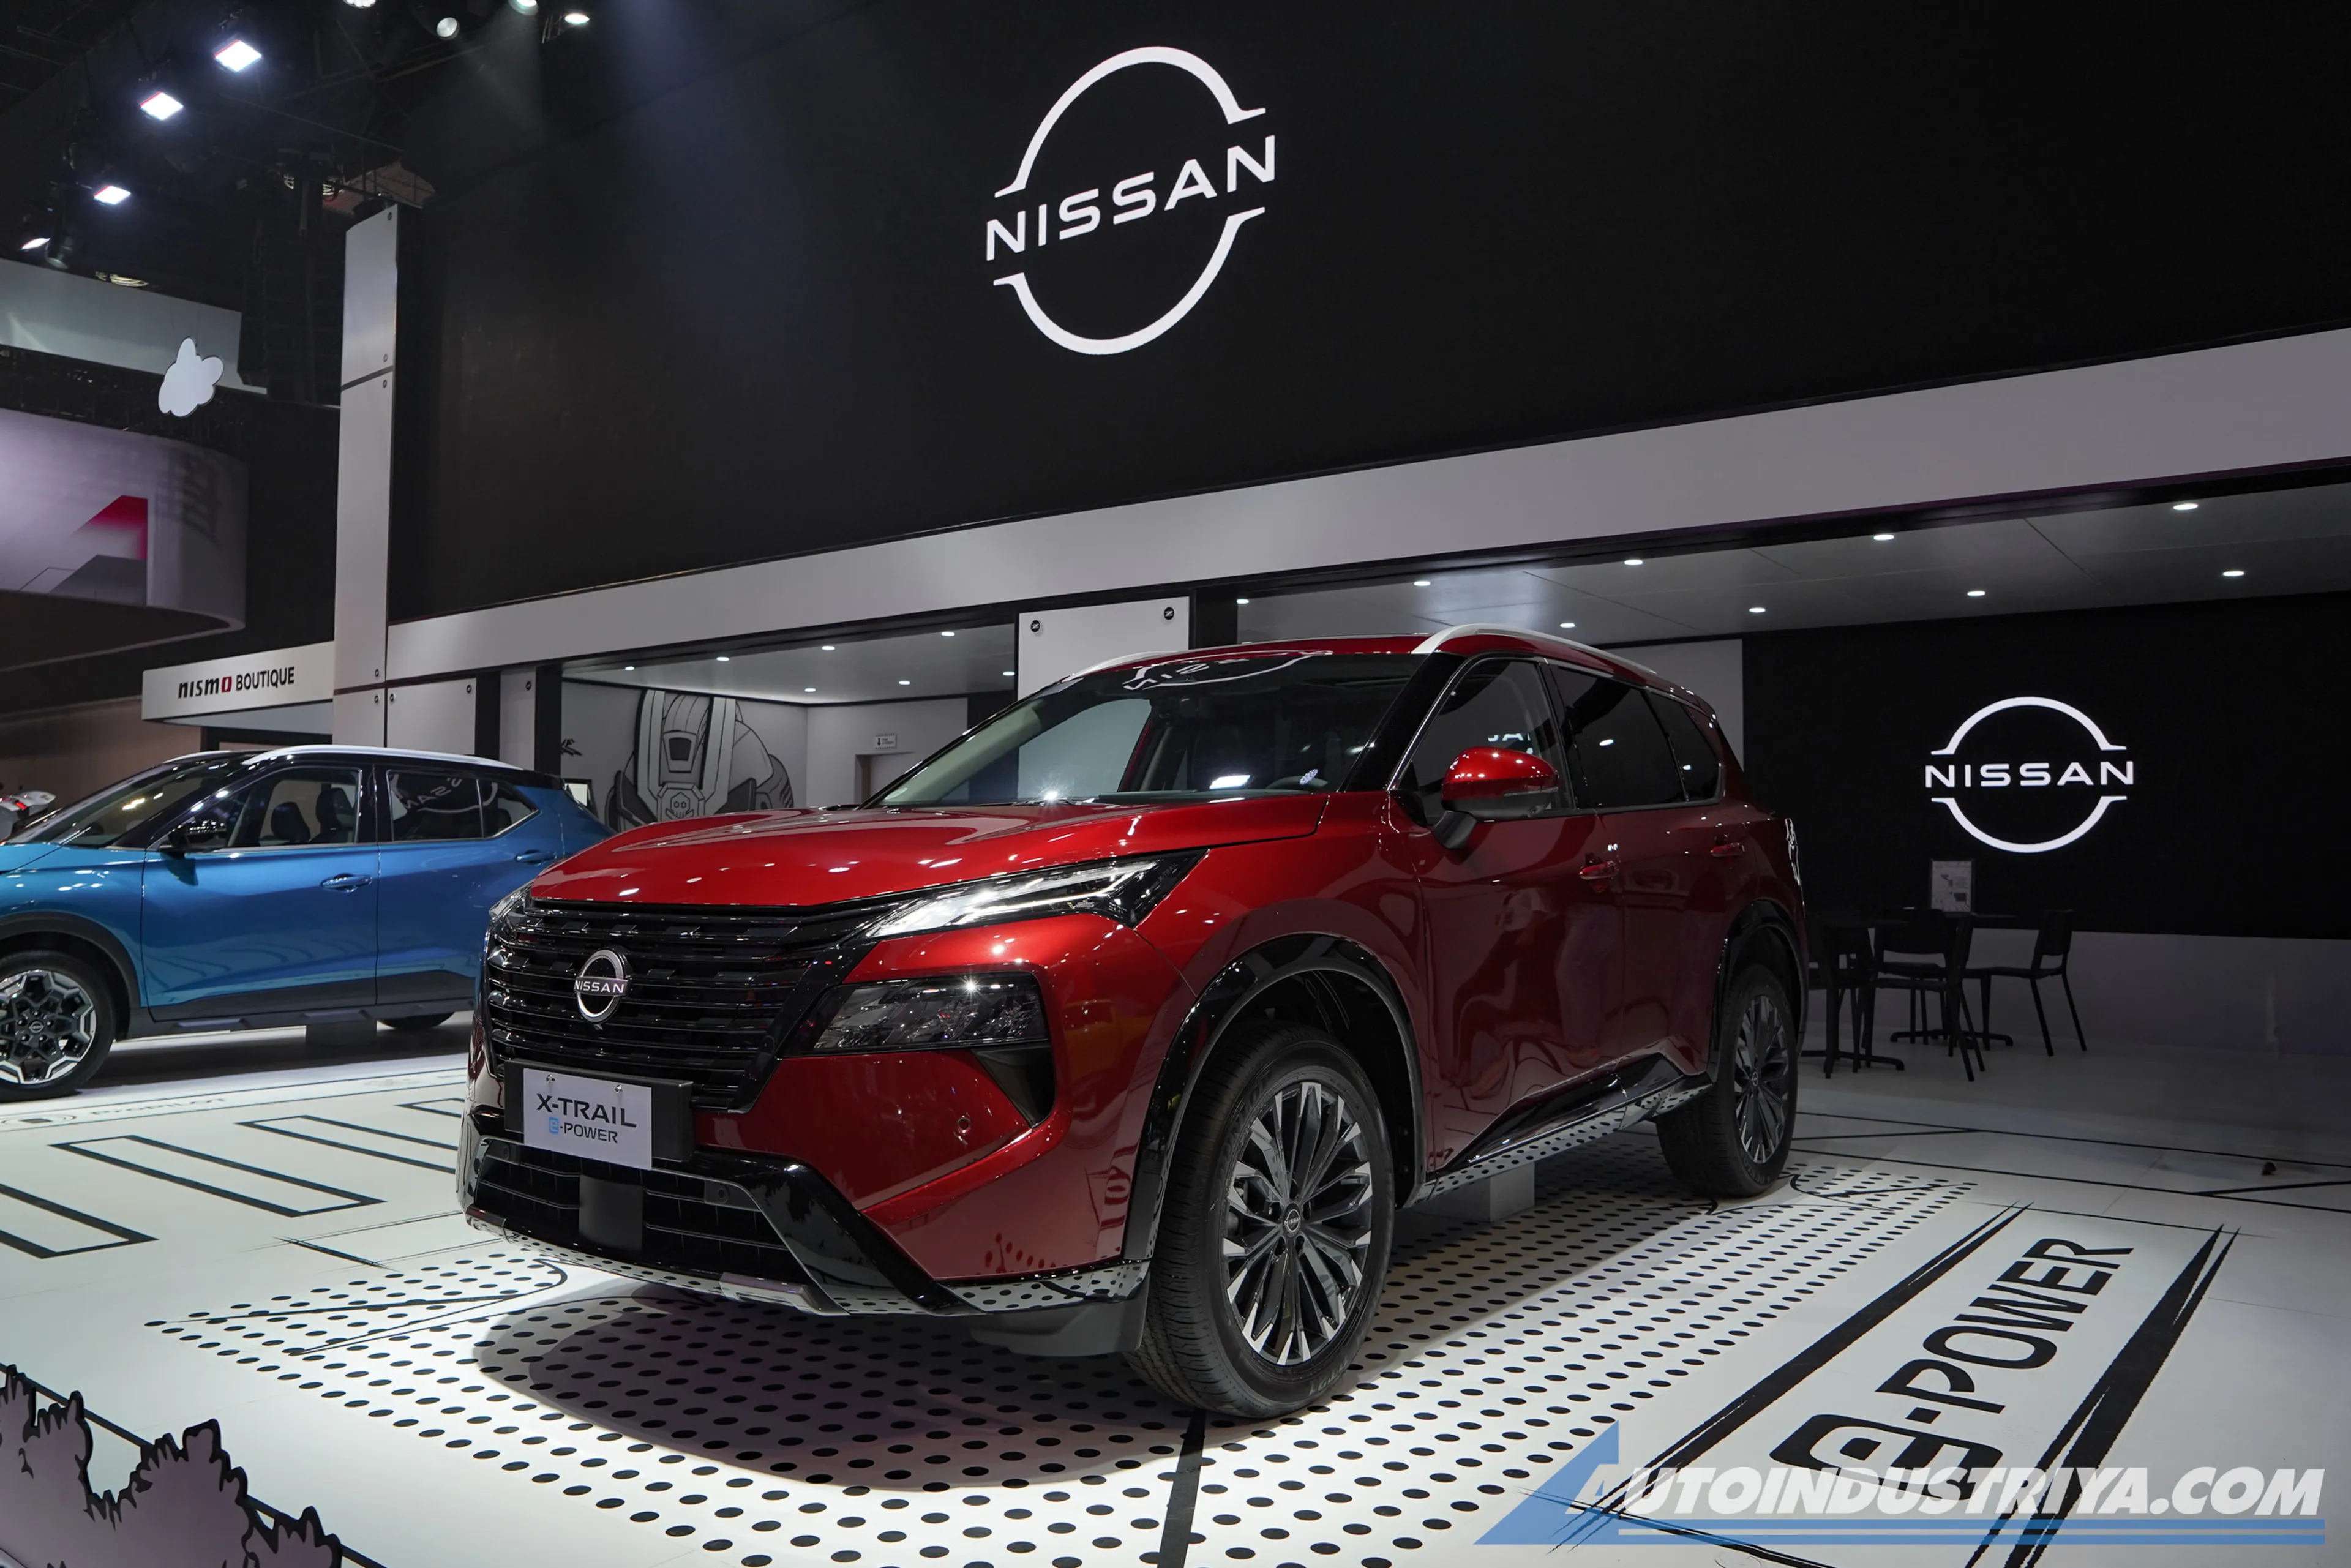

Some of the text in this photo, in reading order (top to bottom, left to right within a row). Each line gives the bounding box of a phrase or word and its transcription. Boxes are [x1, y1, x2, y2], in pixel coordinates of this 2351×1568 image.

[987, 135, 1275, 261] NISSAN
[236, 666, 294, 691] BOUTIQUE
[1925, 760, 2134, 788] NISSAN
[574, 980, 624, 993] NISSAN
[536, 1093, 637, 1128] X-TRAIL
[549, 1117, 618, 1144] e-POWER
[1769, 1237, 2134, 1501] e-POWER
